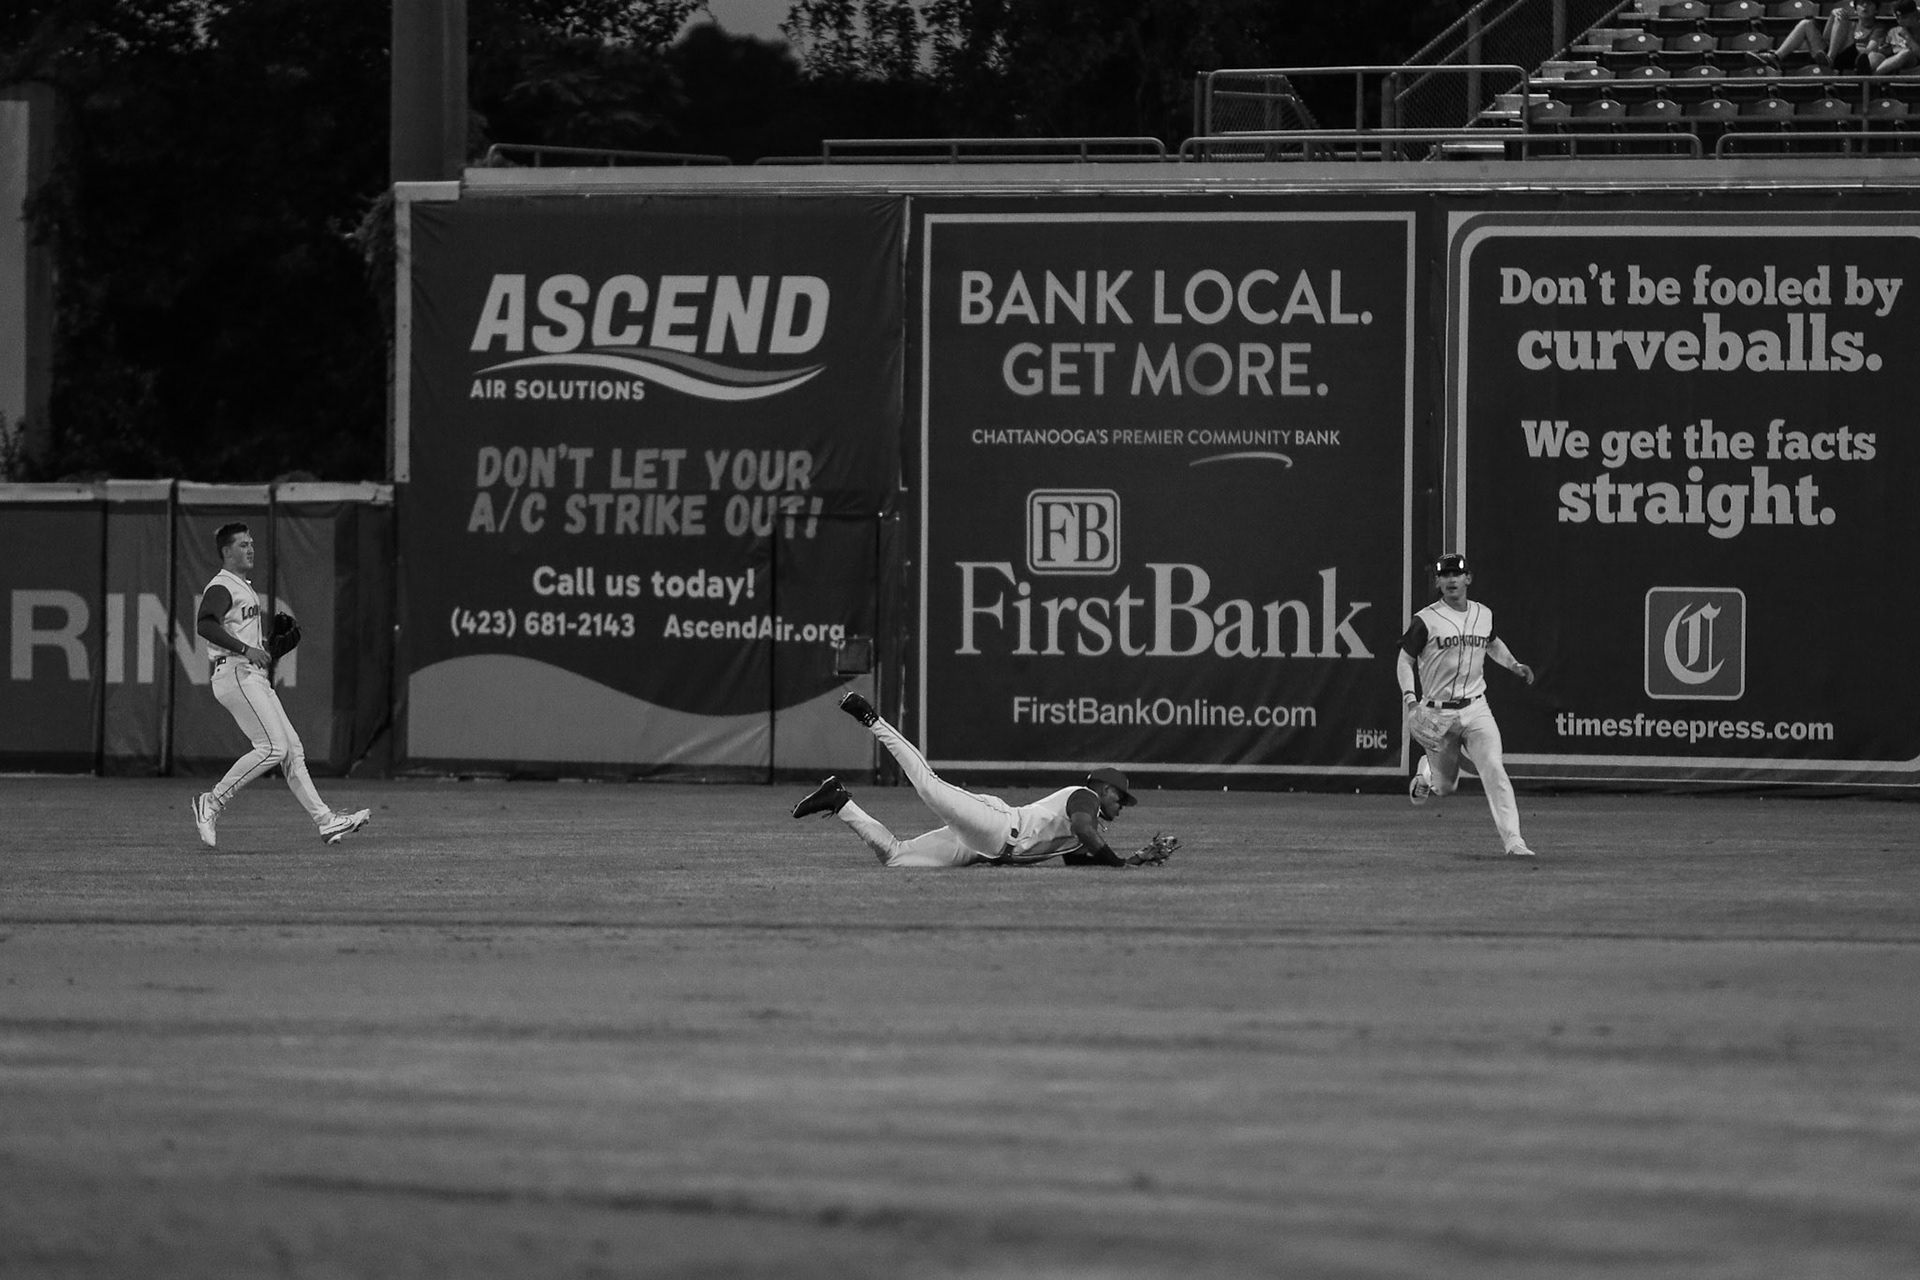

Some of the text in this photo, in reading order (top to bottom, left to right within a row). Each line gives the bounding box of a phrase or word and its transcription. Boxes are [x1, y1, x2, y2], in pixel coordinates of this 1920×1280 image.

[470, 273, 831, 354] ASCEND
[960, 268, 1373, 325] BANK LOCAL.
[1499, 263, 1903, 317] Don't be fooled by
[1517, 312, 1883, 372] curveballs.
[470, 379, 646, 401] AIR SOLUTIONS
[1002, 342, 1330, 398] GET MORE.
[971, 428, 1341, 446] CHATTANOOGA'S PREMIER COMMUNITY BANK
[1520, 418, 1877, 469] We get the facts
[476, 443, 813, 492] DON'T LET YOUR
[467, 489, 824, 540] A/C STRIKE OUT!
[1558, 465, 1837, 539] straight.
[1036, 500, 1111, 564] FB
[532, 566, 756, 606] Call us today!
[954, 561, 1375, 660] FirstBank
[450, 608, 636, 639] (423) 681-2143
[663, 613, 847, 650] AscendAir.org
[1013, 696, 1317, 727] FirstBankOnline.com
[1555, 712, 1835, 744] timesfreepress.com
[1355, 733, 1388, 749] FDIC
